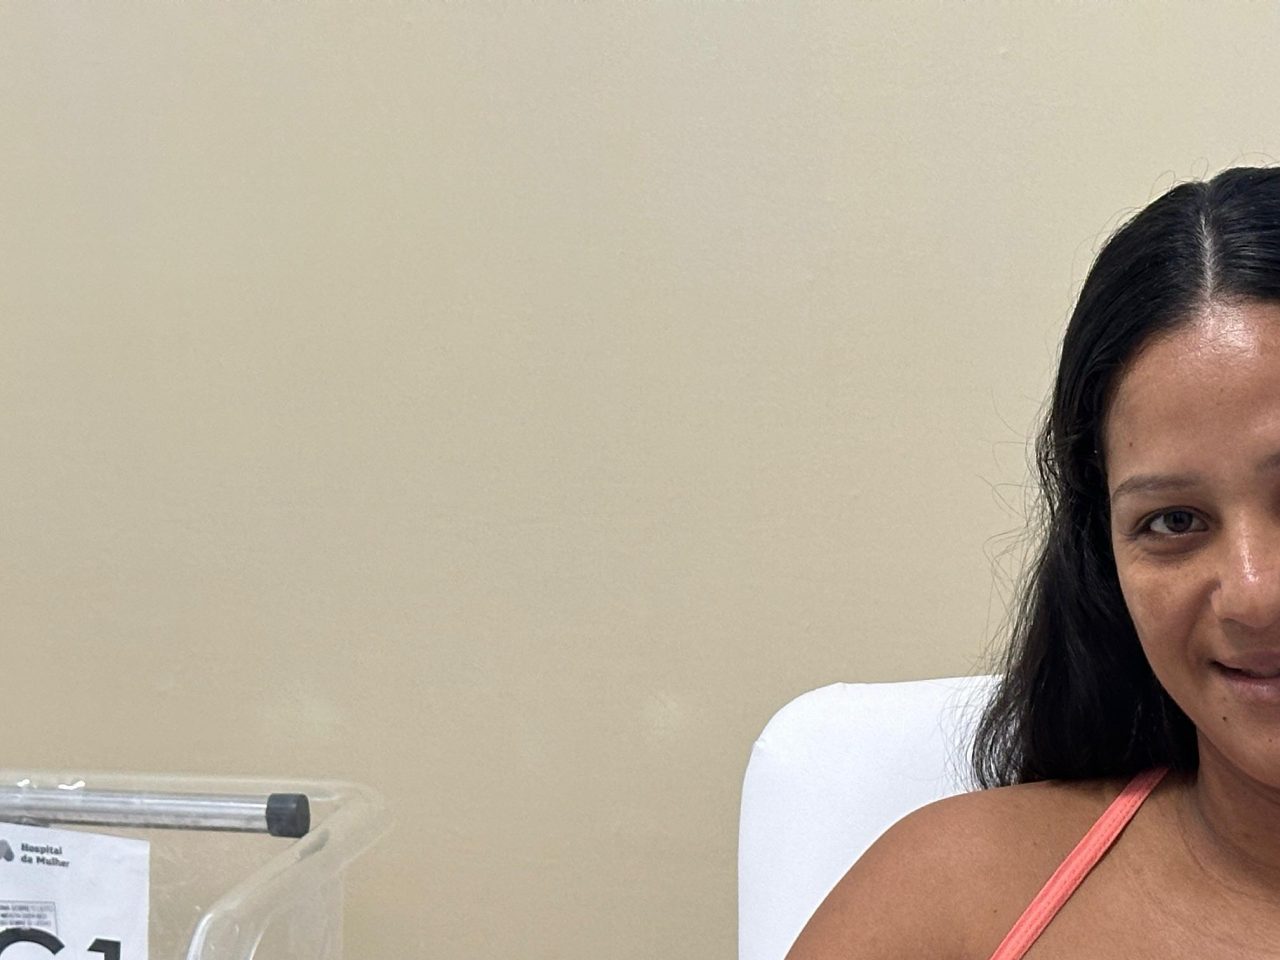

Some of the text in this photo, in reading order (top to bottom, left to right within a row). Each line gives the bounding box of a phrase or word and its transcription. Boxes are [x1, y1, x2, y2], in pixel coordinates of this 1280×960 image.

[20, 842, 62, 855] Hospital
[20, 854, 70, 868] da Mulher
